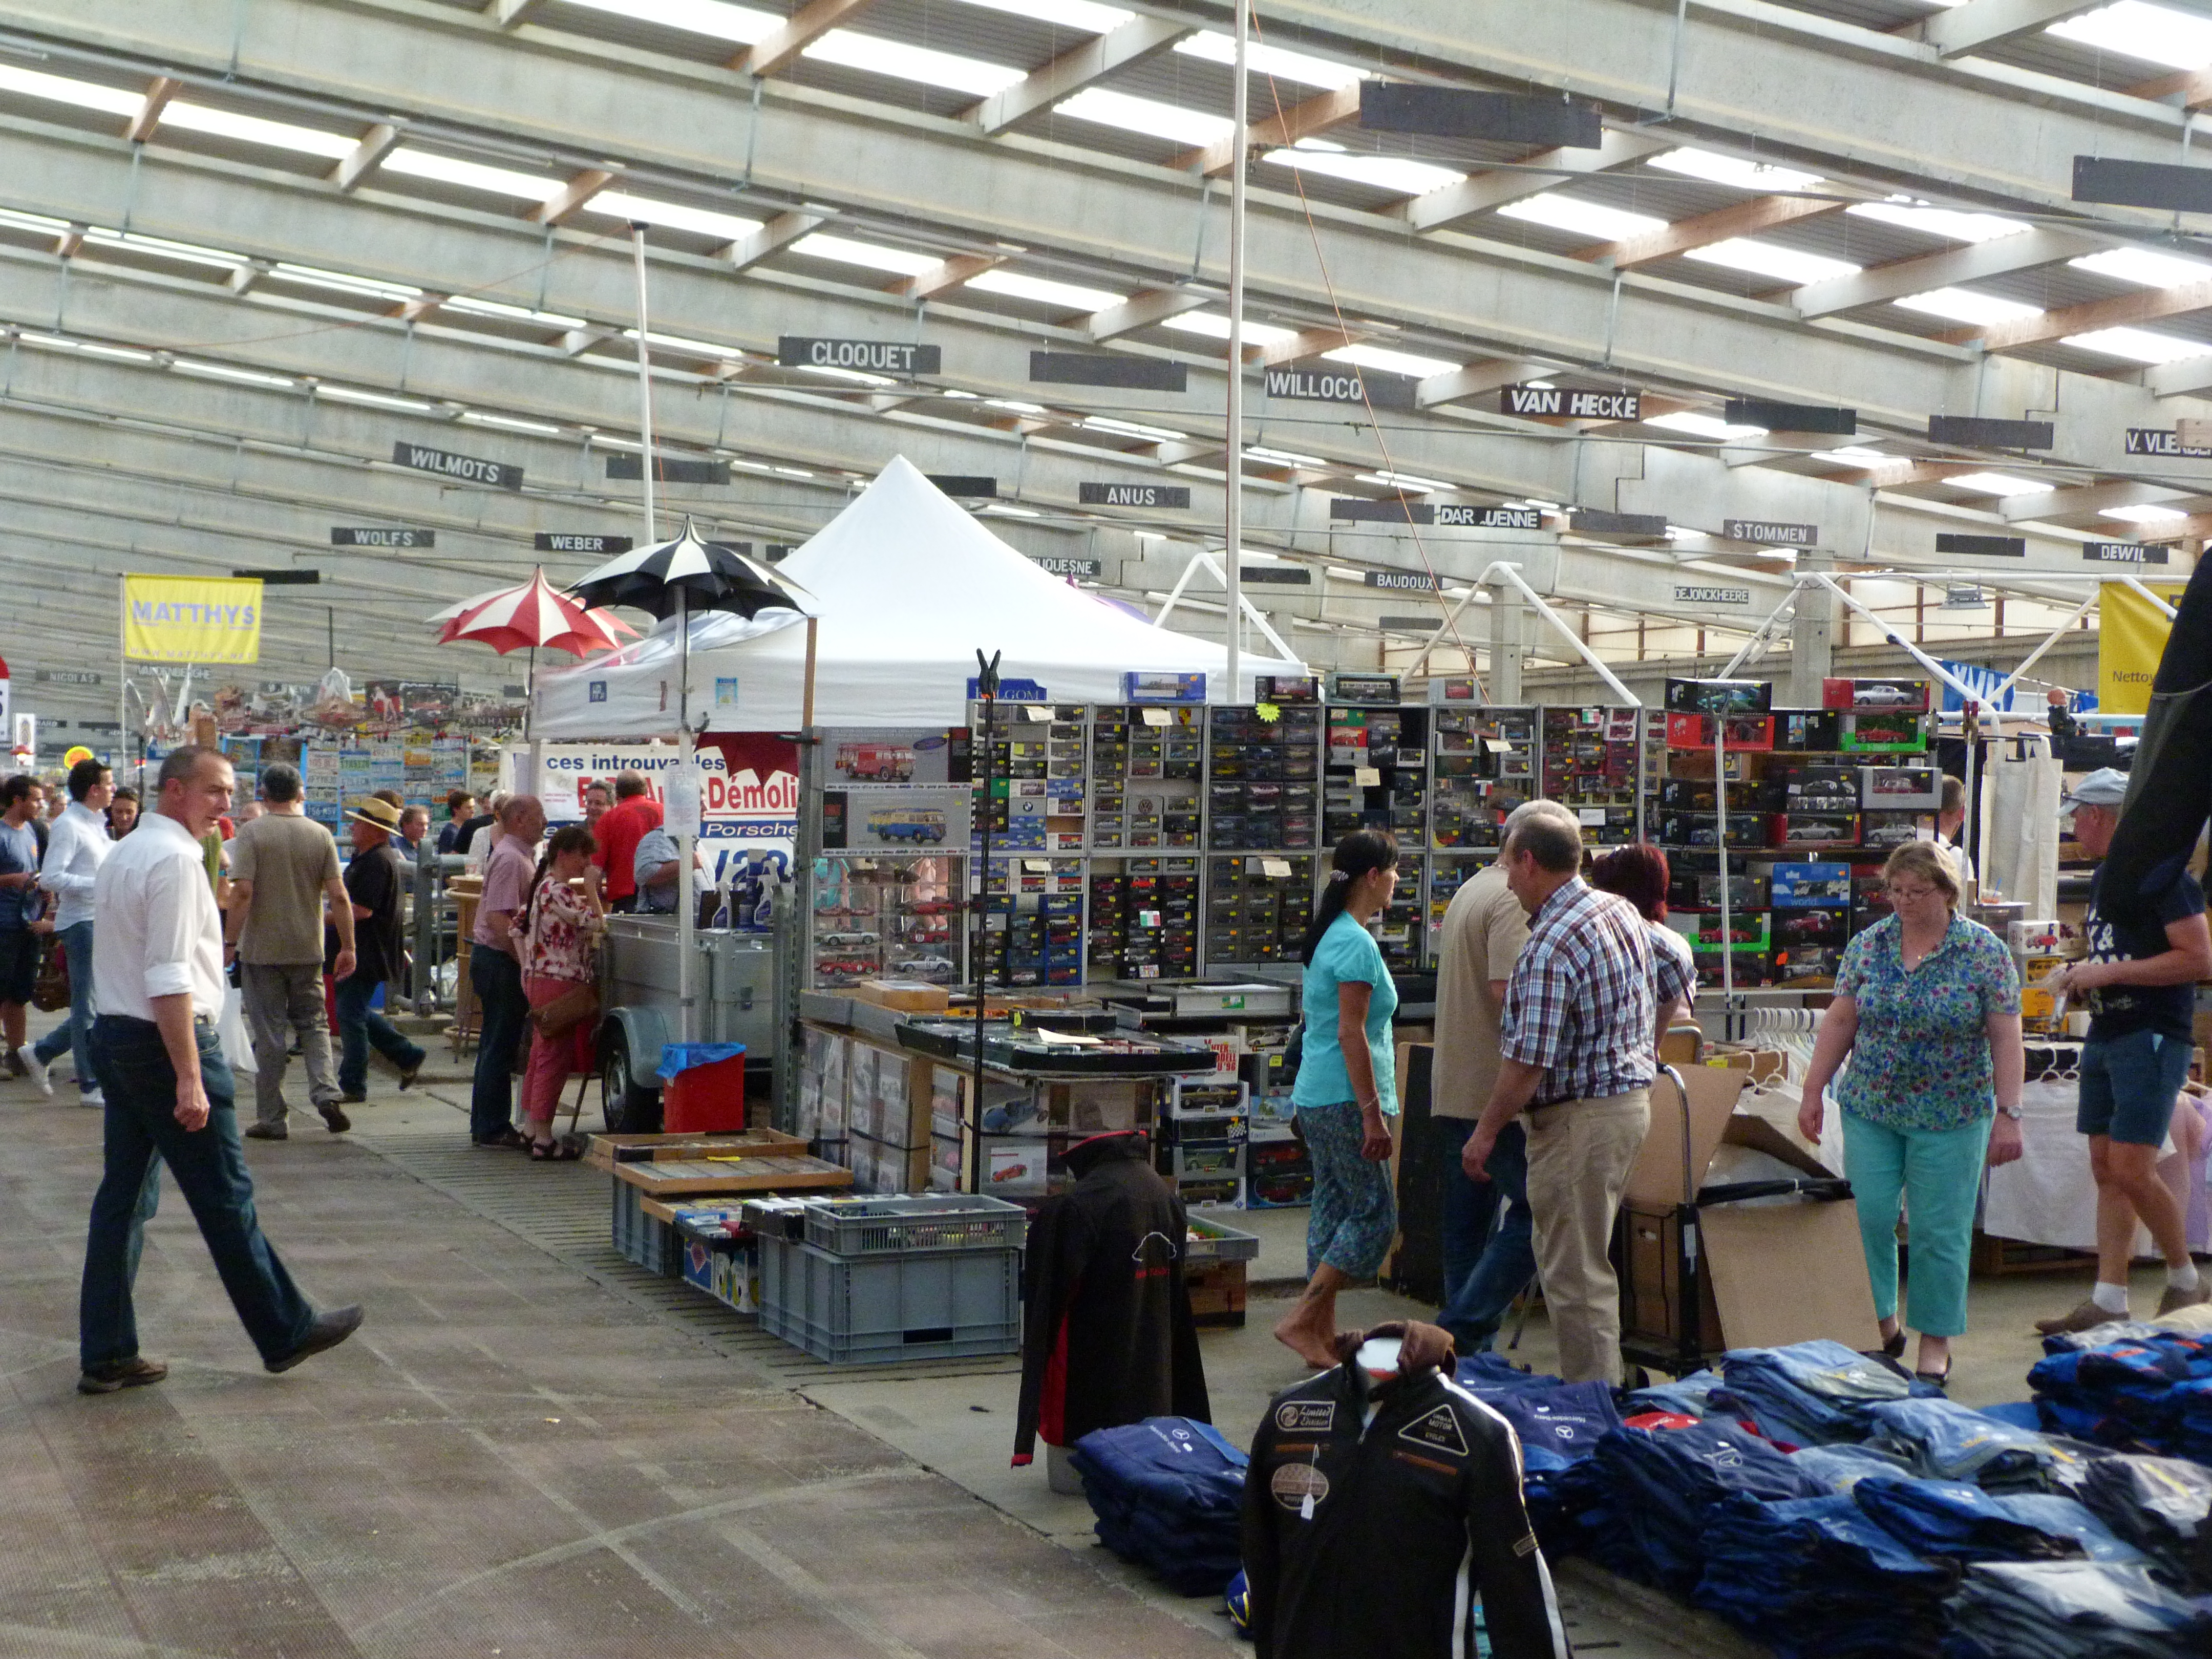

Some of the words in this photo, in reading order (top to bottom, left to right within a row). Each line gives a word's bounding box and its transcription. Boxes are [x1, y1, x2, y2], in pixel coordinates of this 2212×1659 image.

[812, 342, 916, 369] CLOQUET
[1270, 372, 1363, 400] WILLOCQ
[1511, 389, 1560, 413] VAN
[1570, 394, 1637, 418] HECKE
[410, 446, 499, 483] WILMOTS
[1107, 487, 1155, 505] ANUS
[354, 529, 413, 546] WOLFS
[1733, 523, 1807, 542] STOMMEN
[550, 535, 604, 552] WEBER
[2101, 545, 2146, 562] DEWIL
[1376, 573, 1434, 589] BAUDOUX
[1674, 587, 1748, 602] DEJONCKHEERE
[132, 600, 255, 625] MATTHYS
[592, 754, 726, 770] introuvales
[706, 822, 798, 837] Porsche
[1299, 1406, 1331, 1417] Limited
[1428, 1419, 1453, 1431] MOTOR
